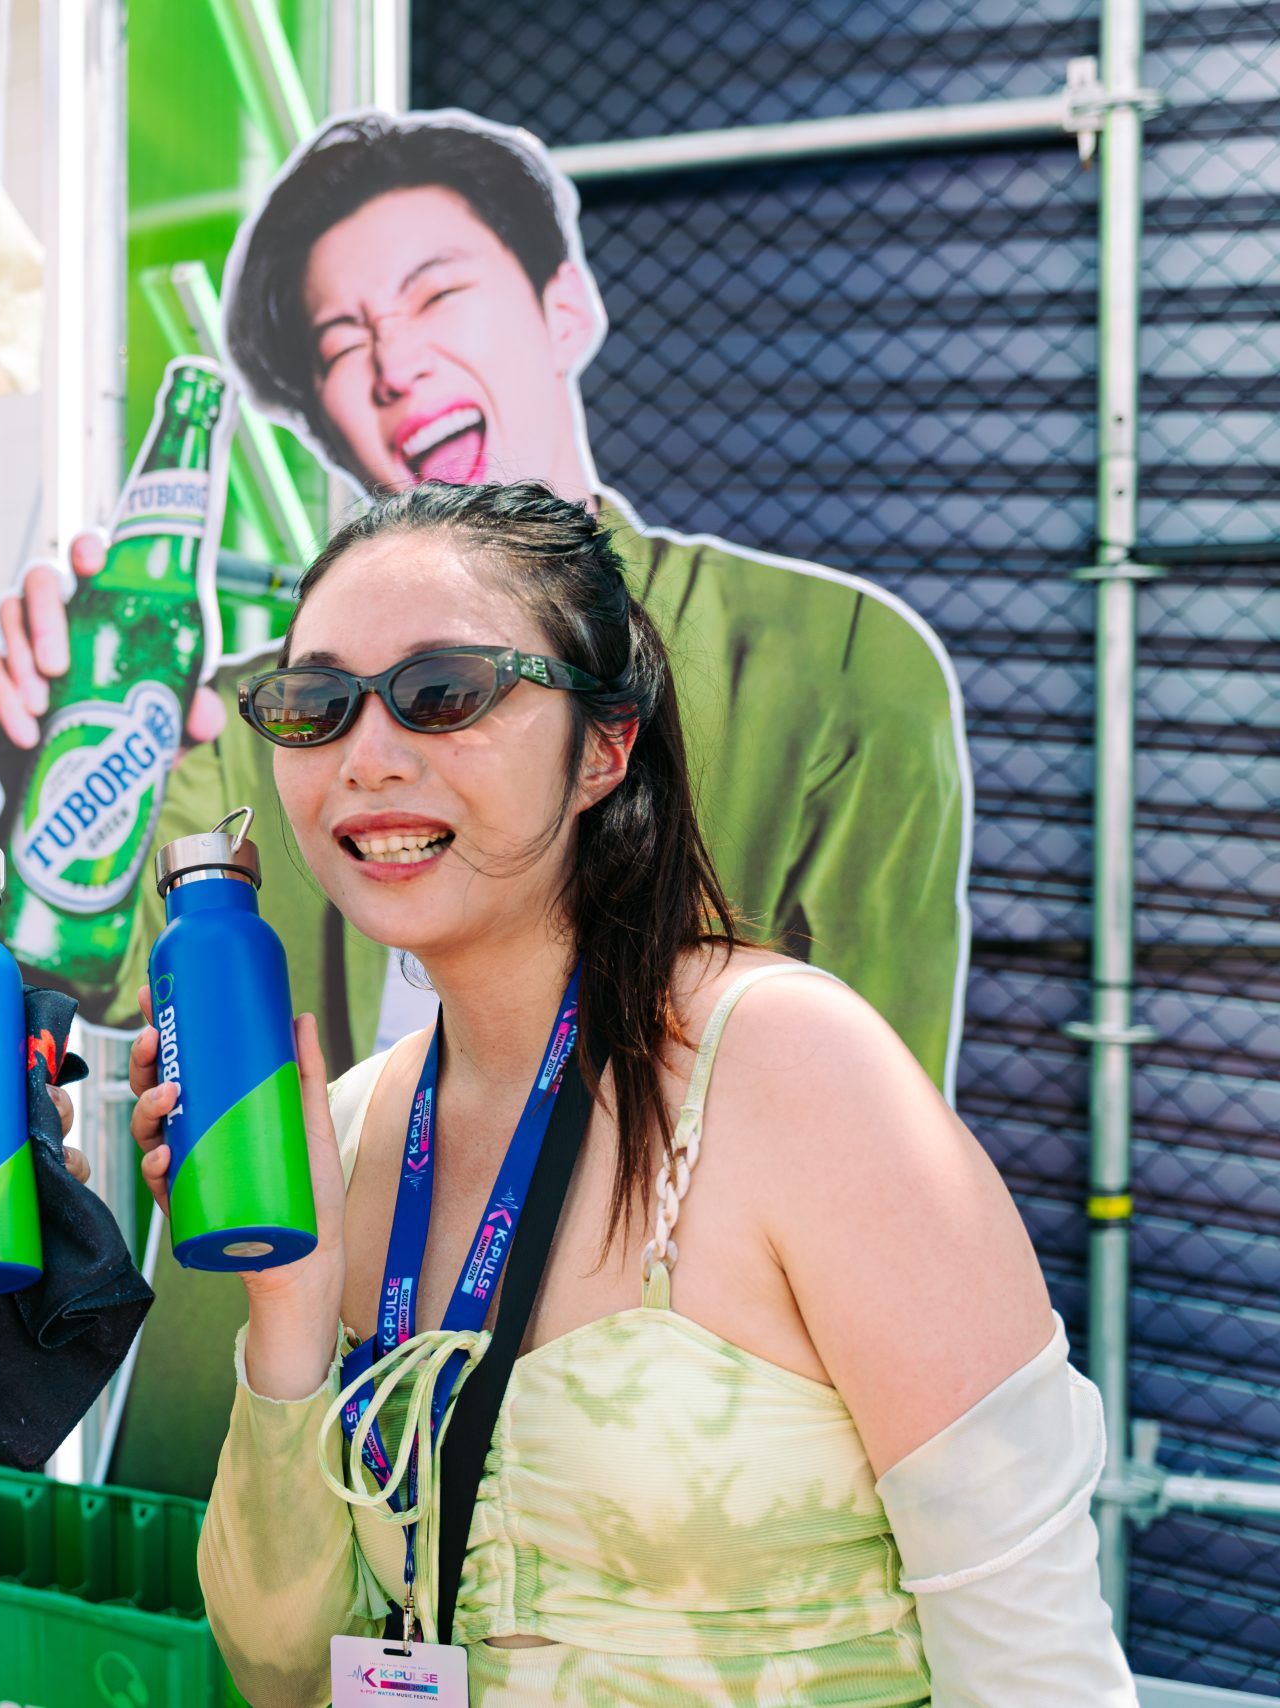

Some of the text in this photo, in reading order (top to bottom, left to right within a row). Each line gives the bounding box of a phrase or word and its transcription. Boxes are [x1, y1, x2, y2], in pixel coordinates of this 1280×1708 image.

[25, 730, 157, 870] TUBORG
[552, 1033, 565, 1058] HANOI
[409, 1090, 425, 1155] K-PULSE
[467, 1235, 489, 1281] HANOI 2026
[473, 1227, 508, 1301] K-PULSE
[384, 1277, 401, 1346] K-PULSE
[399, 1309, 408, 1335] HANOI
[379, 1668, 439, 1684] K-PULSE
